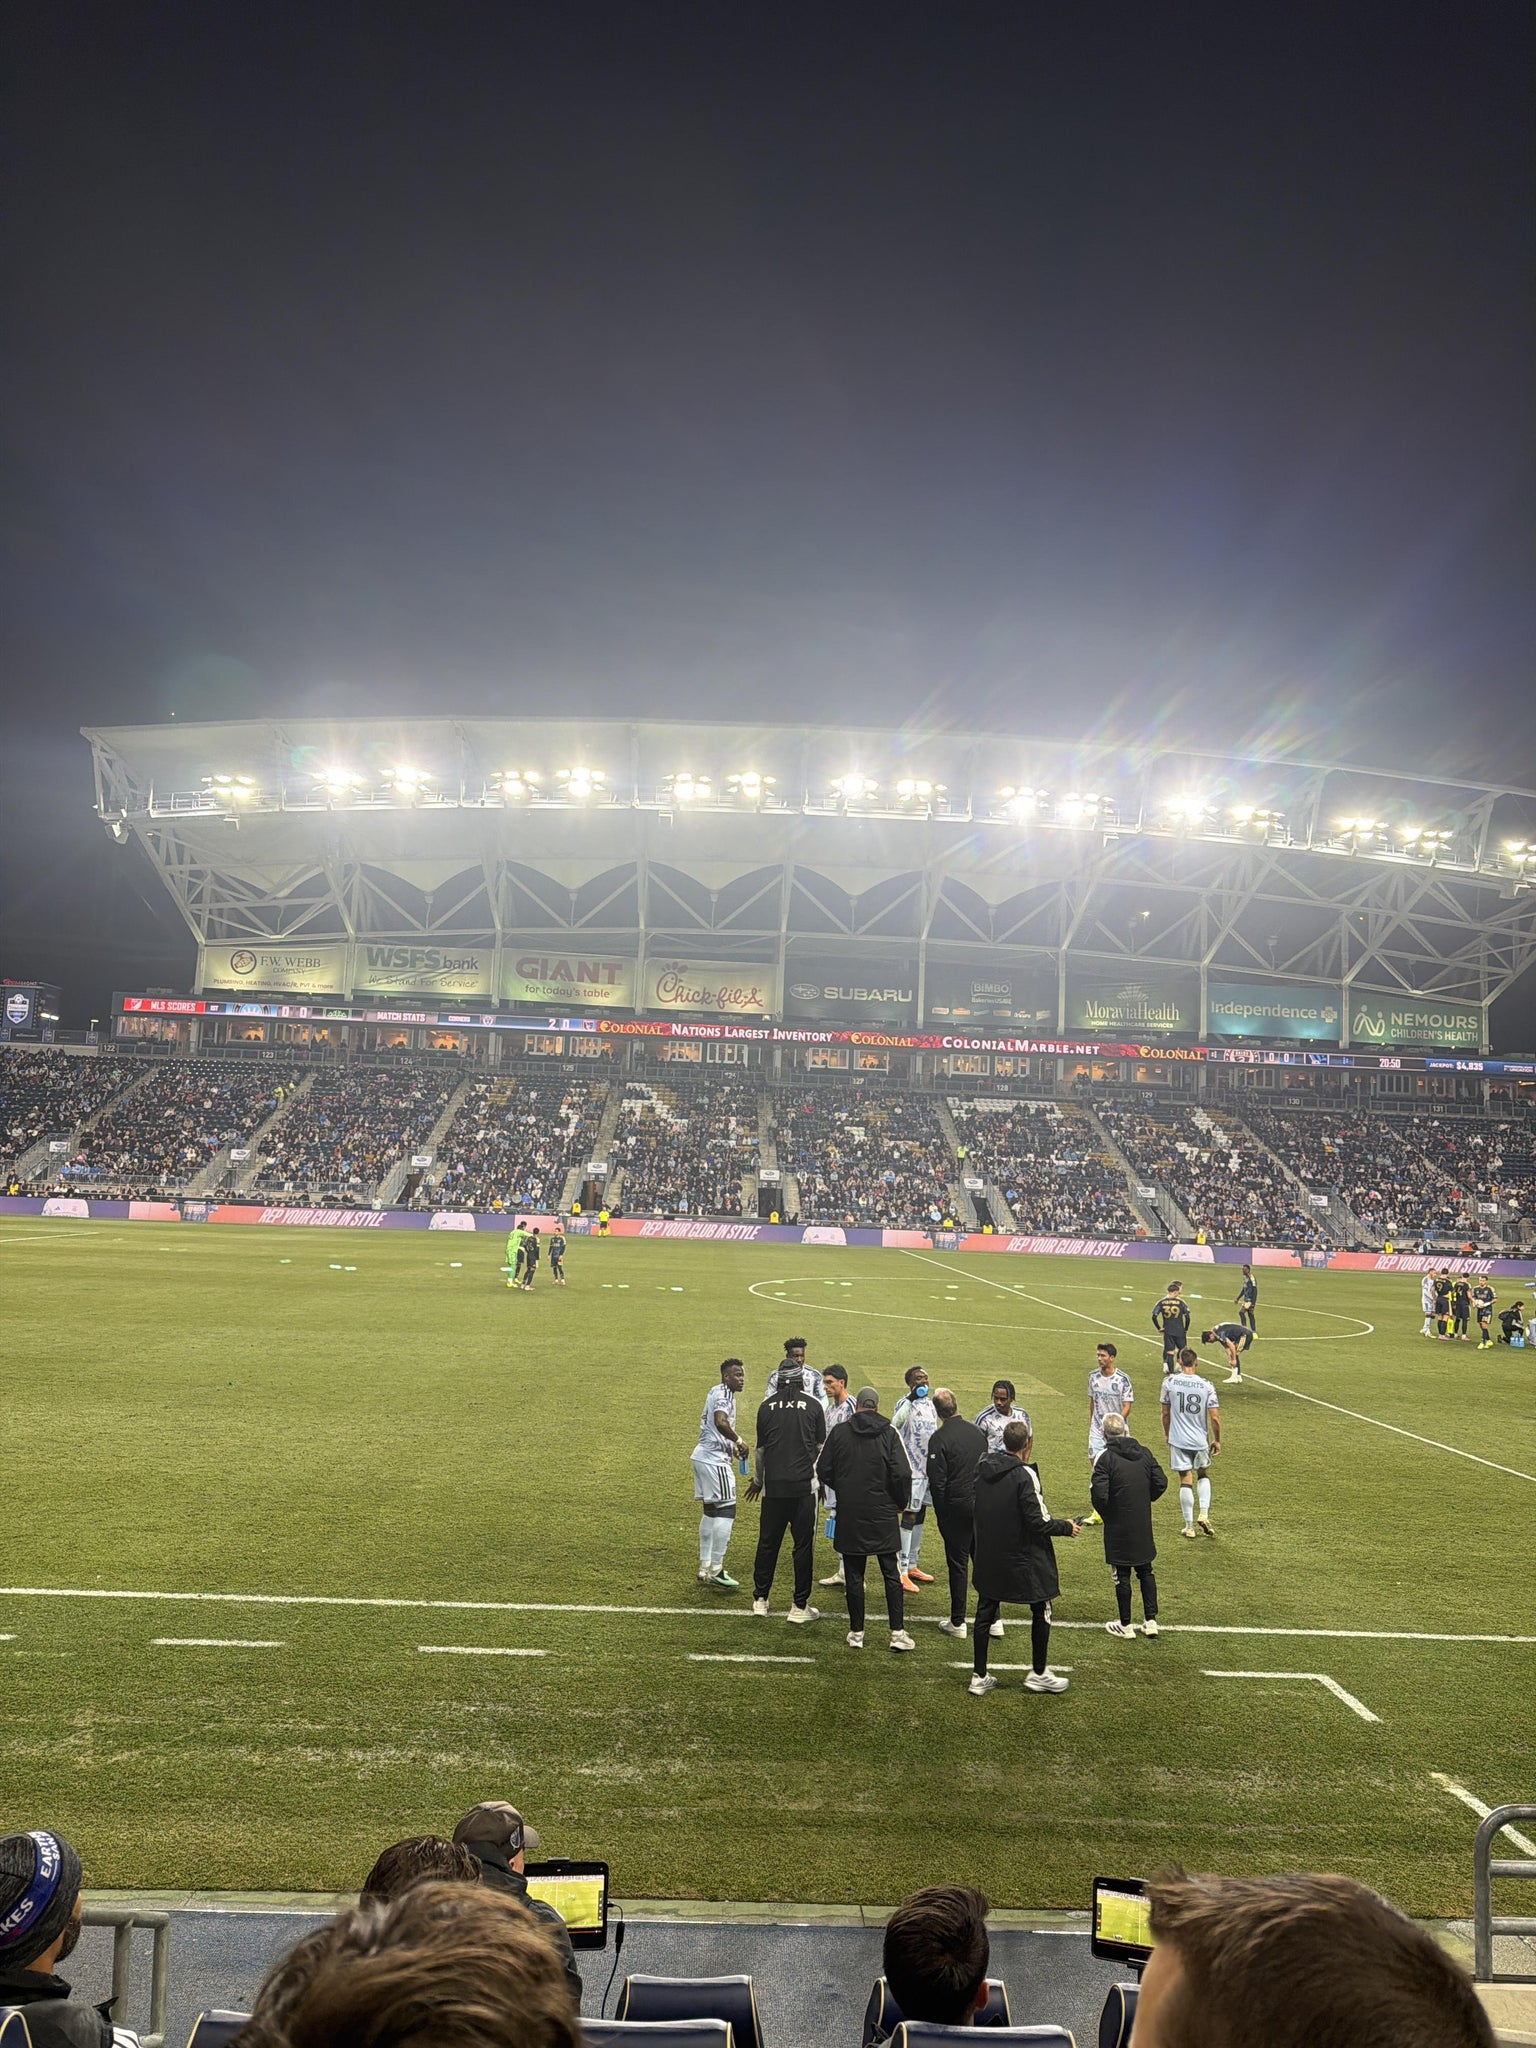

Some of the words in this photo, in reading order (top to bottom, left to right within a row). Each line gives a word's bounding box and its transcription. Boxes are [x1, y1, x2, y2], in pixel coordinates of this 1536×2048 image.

[260, 955, 281, 967] F.W.
[285, 957, 321, 968] WEBB
[367, 946, 441, 969] WSFS
[443, 955, 479, 970] bank
[515, 956, 623, 985] GIANT
[368, 975, 381, 984] We
[386, 975, 417, 986] Stand
[420, 977, 437, 987] For
[440, 977, 477, 988] Service
[973, 983, 1009, 993] BIMBO
[525, 984, 542, 994] for
[542, 986, 580, 998] today's
[583, 989, 610, 999] table
[656, 970, 764, 1010] Chick-fil-A
[823, 986, 913, 1002] SUBARU
[150, 1001, 166, 1011] MLS
[168, 1001, 196, 1012] SCORES
[1085, 1000, 1180, 1021] MoraviaHealth
[1211, 1000, 1318, 1018] Independence
[376, 1011, 401, 1021] MATCH
[403, 1013, 426, 1022] STATS
[548, 1018, 557, 1029] 2
[1391, 1012, 1478, 1029] NEMOURS
[600, 1020, 664, 1035] COLONIAL
[671, 1023, 721, 1036] NATIONS
[725, 1026, 770, 1039] LARGEST
[773, 1028, 833, 1042] INVENTORY
[1391, 1028, 1443, 1041] CHILDREN'S
[1444, 1030, 1479, 1042] HEALTH
[851, 1032, 914, 1047] COLONIAL
[942, 1036, 1100, 1055] COLONIALMARBLE.NET
[104, 1044, 116, 1052] 122
[262, 1051, 274, 1059] 123
[1140, 1045, 1205, 1061] COLONIAL
[1379, 1058, 1400, 1068] 20:50
[996, 1084, 1009, 1092] 128
[258, 1208, 285, 1224] REP
[281, 1209, 314, 1225] YOUR
[310, 1210, 341, 1226] CLUB
[337, 1211, 355, 1226] IN
[351, 1211, 388, 1227] STYLE
[639, 1221, 664, 1236] REP
[660, 1222, 691, 1237] YOUR
[688, 1223, 717, 1238] CLUB
[713, 1224, 732, 1239] IN
[727, 1225, 762, 1240] STYLE
[1006, 1237, 1031, 1251] REP
[1028, 1238, 1058, 1253] YOUR
[1055, 1239, 1085, 1254] CLUB
[1081, 1240, 1099, 1256] IN
[1094, 1241, 1129, 1257] STYLE
[1374, 1255, 1398, 1270] REP
[1395, 1256, 1426, 1272] YOUR
[1423, 1257, 1453, 1273] CLUB
[1448, 1258, 1466, 1274] IN
[1461, 1259, 1496, 1275] STYLE
[1161, 1305, 1180, 1319] 39
[1173, 1379, 1205, 1389] ROBERTS
[768, 1400, 807, 1411] TIXR
[1176, 1391, 1202, 1415] 18
[0, 1898, 35, 1936] KES
